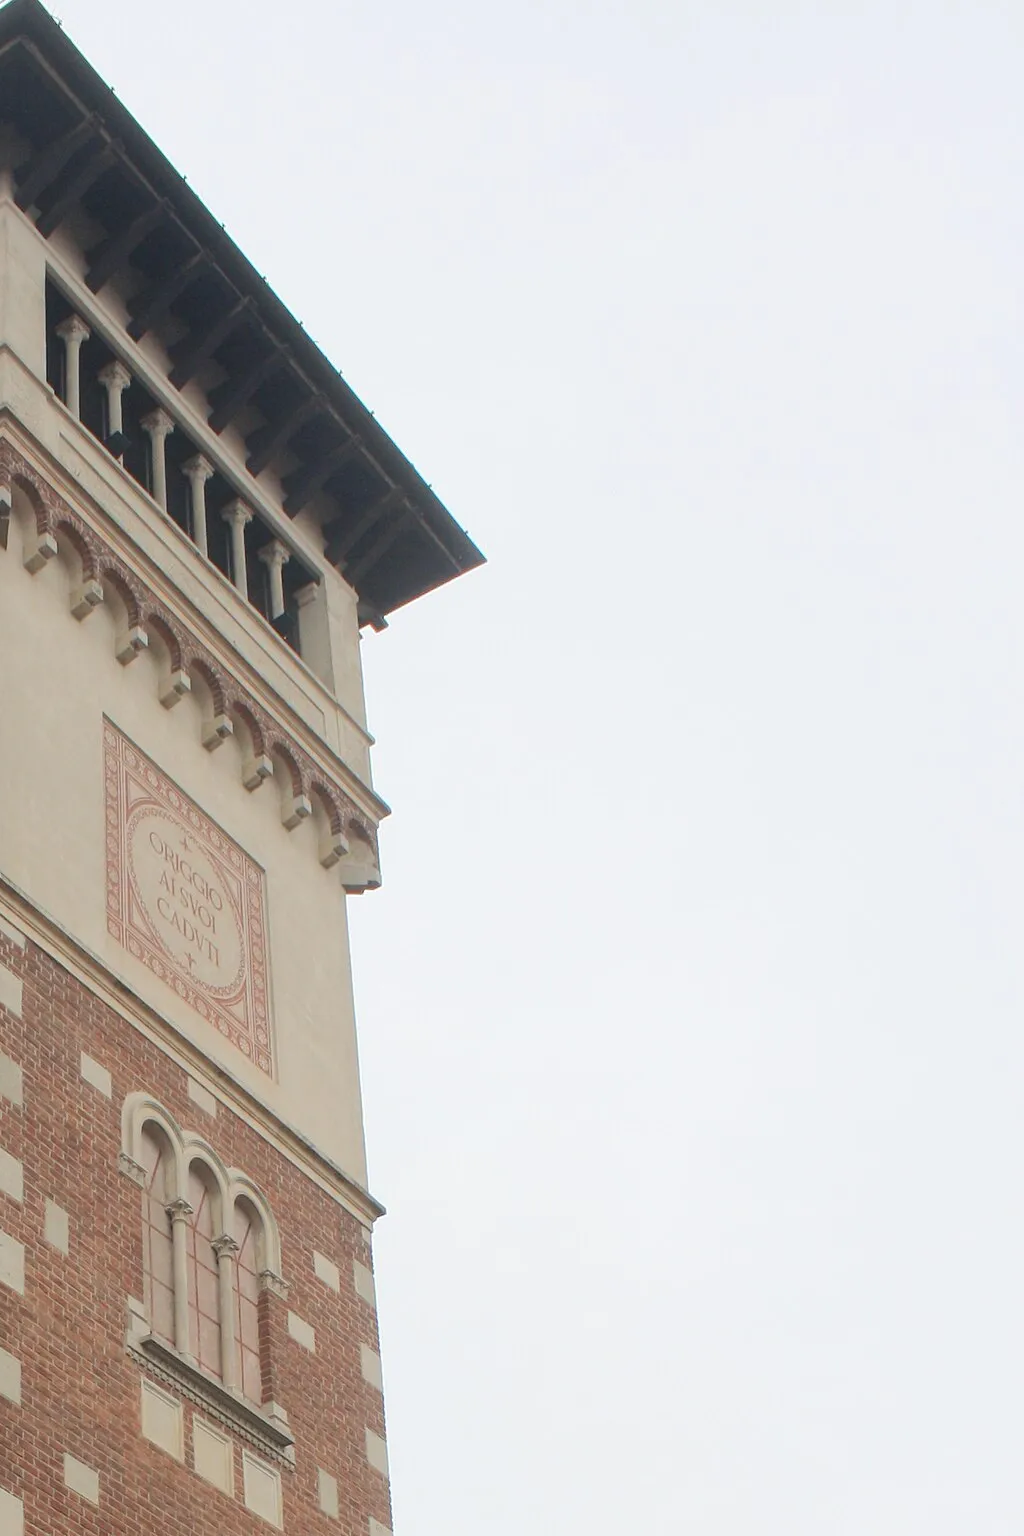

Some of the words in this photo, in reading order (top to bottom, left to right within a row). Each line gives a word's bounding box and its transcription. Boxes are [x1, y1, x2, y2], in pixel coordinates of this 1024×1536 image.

[149, 832, 223, 911] ORIGGIO
[159, 870, 175, 896] AI
[180, 887, 216, 934] SVOI
[157, 897, 219, 967] CADVTI
